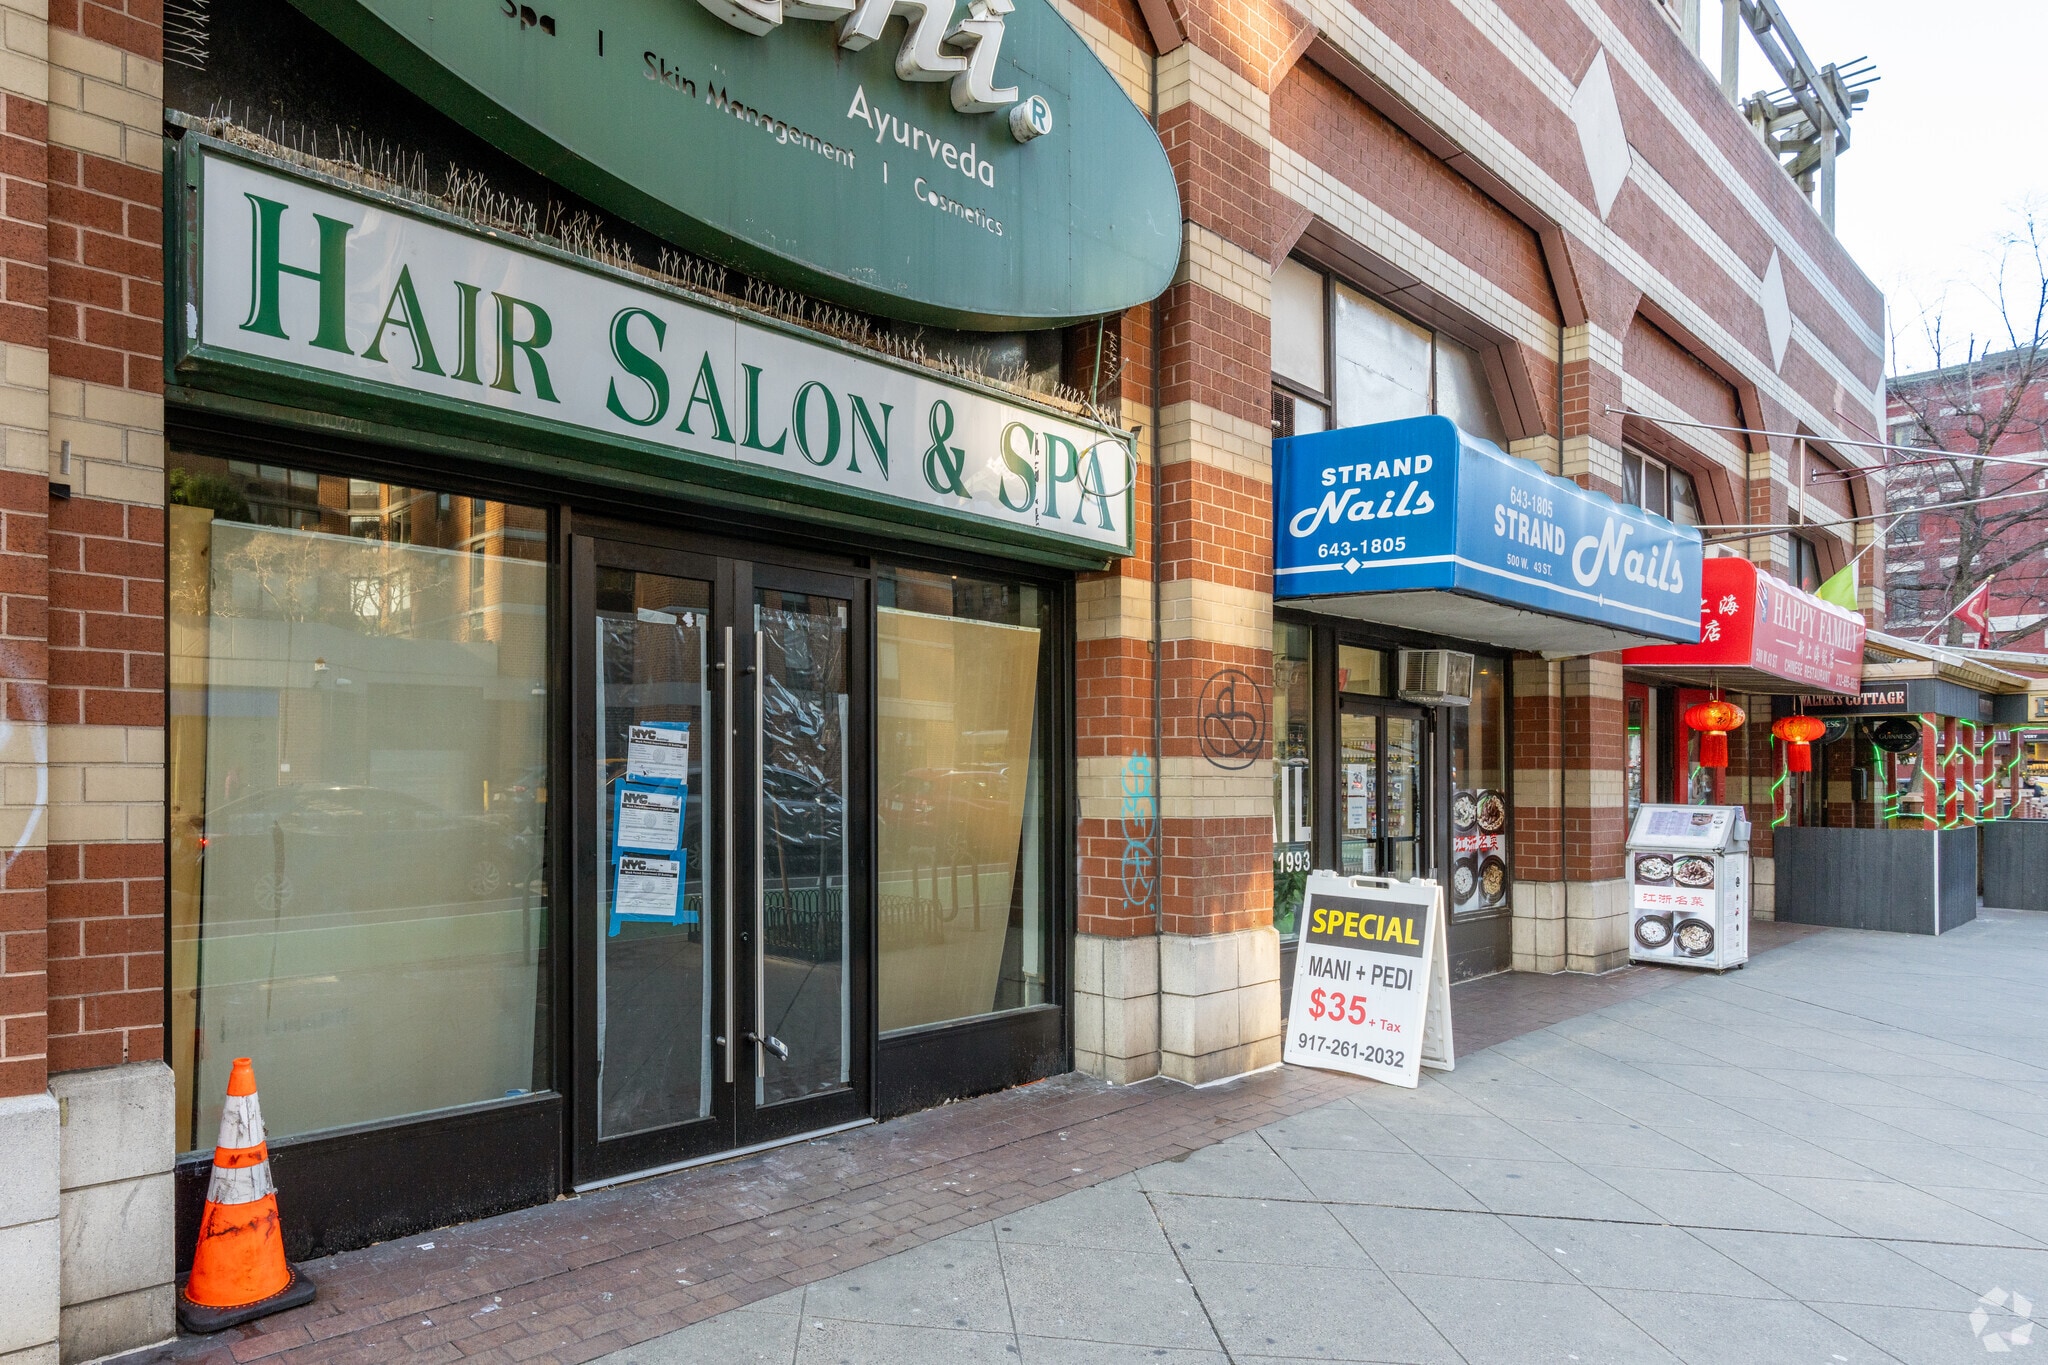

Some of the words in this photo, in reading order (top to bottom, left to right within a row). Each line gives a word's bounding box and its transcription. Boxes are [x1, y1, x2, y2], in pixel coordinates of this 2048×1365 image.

[642, 51, 697, 98] Skin
[705, 79, 857, 170] Management
[846, 84, 996, 190] Ayurveda
[914, 176, 1004, 238] Cosmetics
[237, 191, 561, 404] HAIR
[604, 306, 894, 482] SALON
[921, 399, 972, 499] &
[998, 421, 1116, 532] SPA
[1321, 454, 1434, 487] STRAND
[1289, 480, 1436, 539] Nails
[1510, 485, 1554, 519] 643-1805
[1318, 536, 1407, 559] 643-1805
[1493, 503, 1566, 557] STRAND
[1506, 552, 1521, 567] 500
[1533, 561, 1543, 574] 43
[1571, 516, 1684, 594] Nails
[1773, 591, 1818, 639] HAPPY
[1819, 609, 1860, 653] FAMILY
[1784, 658, 1803, 677] CHINESE
[1804, 664, 1831, 684] RESTAURANT
[1845, 691, 1905, 706] COTTAGE
[631, 728, 657, 739] NYC
[623, 792, 649, 804] NYC
[621, 859, 647, 870] NYC
[1277, 850, 1311, 874] 1993
[1311, 908, 1420, 946] SPECIAL
[1308, 955, 1351, 983] MANI
[1356, 968, 1366, 981] +
[1371, 964, 1413, 991] PEDI
[1308, 987, 1368, 1025] $35
[1380, 1018, 1402, 1034] Tax
[1298, 1032, 1406, 1069] 917-261-2032
